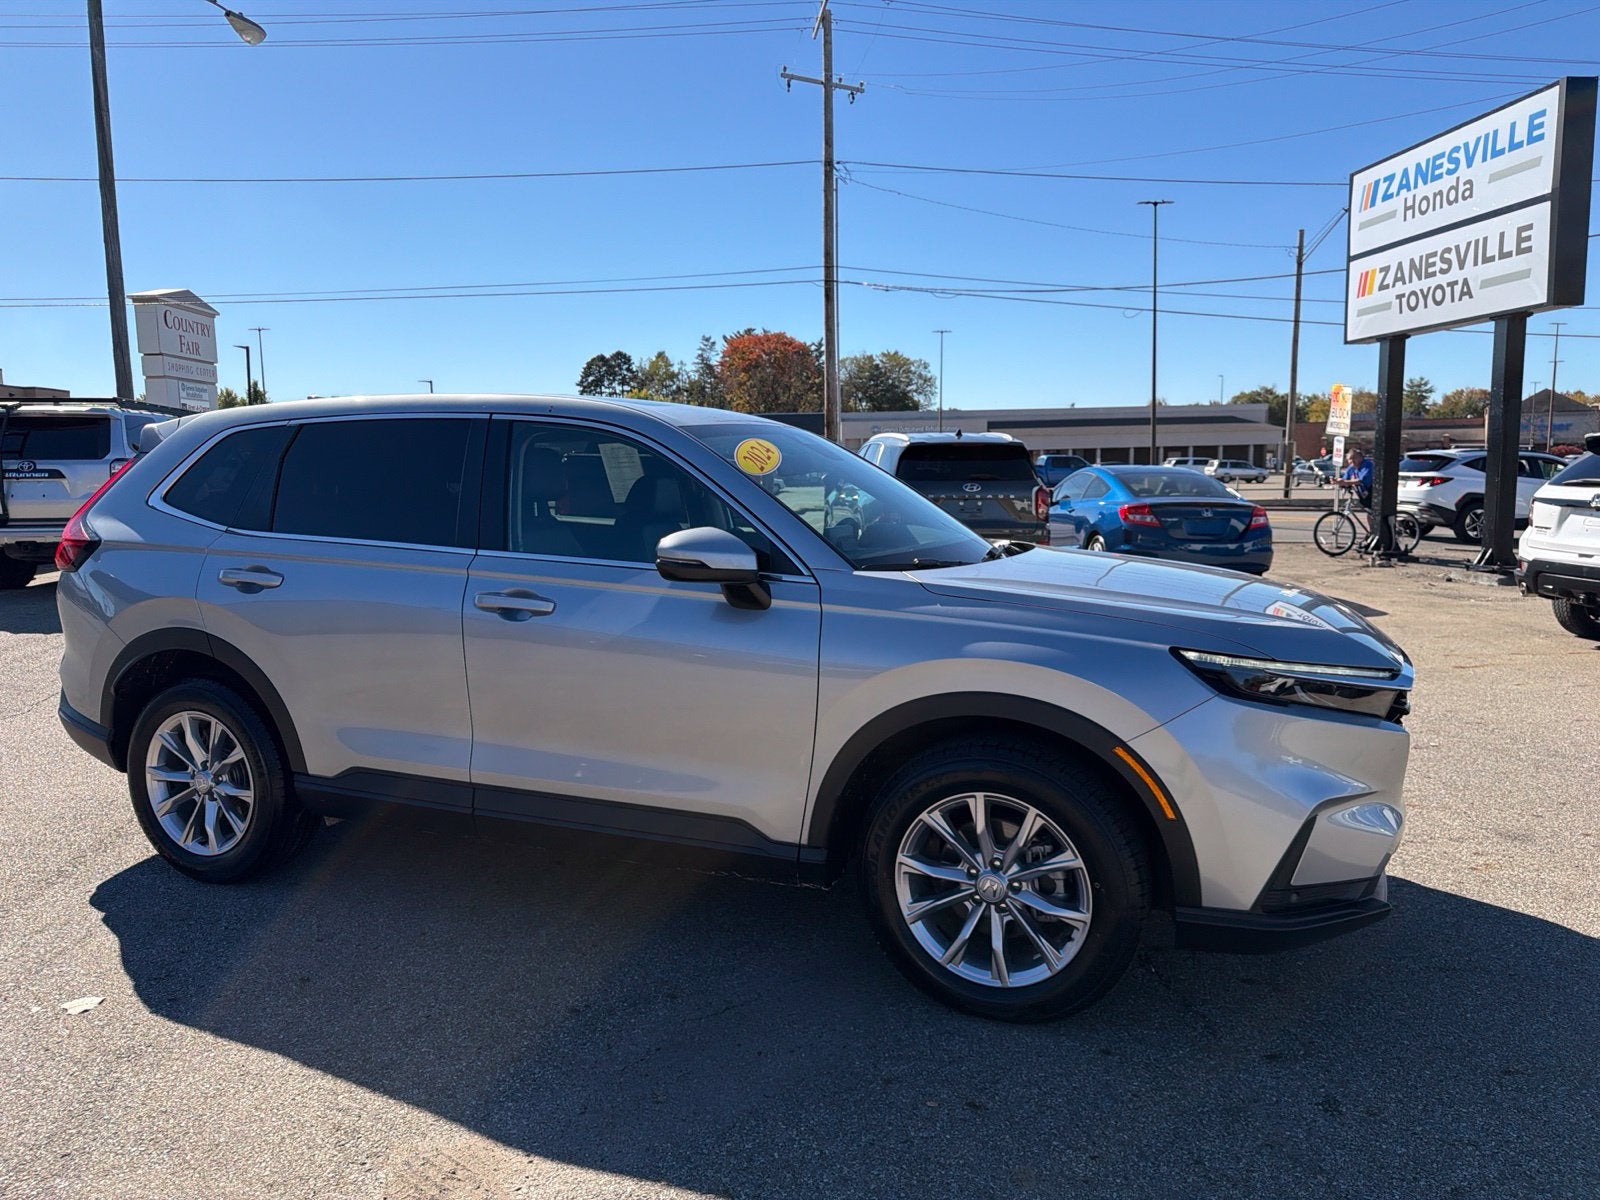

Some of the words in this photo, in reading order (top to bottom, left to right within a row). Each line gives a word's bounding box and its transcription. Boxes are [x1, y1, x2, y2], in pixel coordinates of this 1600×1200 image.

[1381, 108, 1547, 203] ZANESVILLE
[1403, 176, 1474, 222] Honda
[1377, 222, 1534, 292] ZANESVILLE
[1395, 277, 1474, 314] TOYOTA
[163, 309, 211, 338] COUNTRY
[178, 334, 201, 357] FAIR
[167, 361, 193, 375] SHOPPING
[743, 440, 775, 472] 2024
